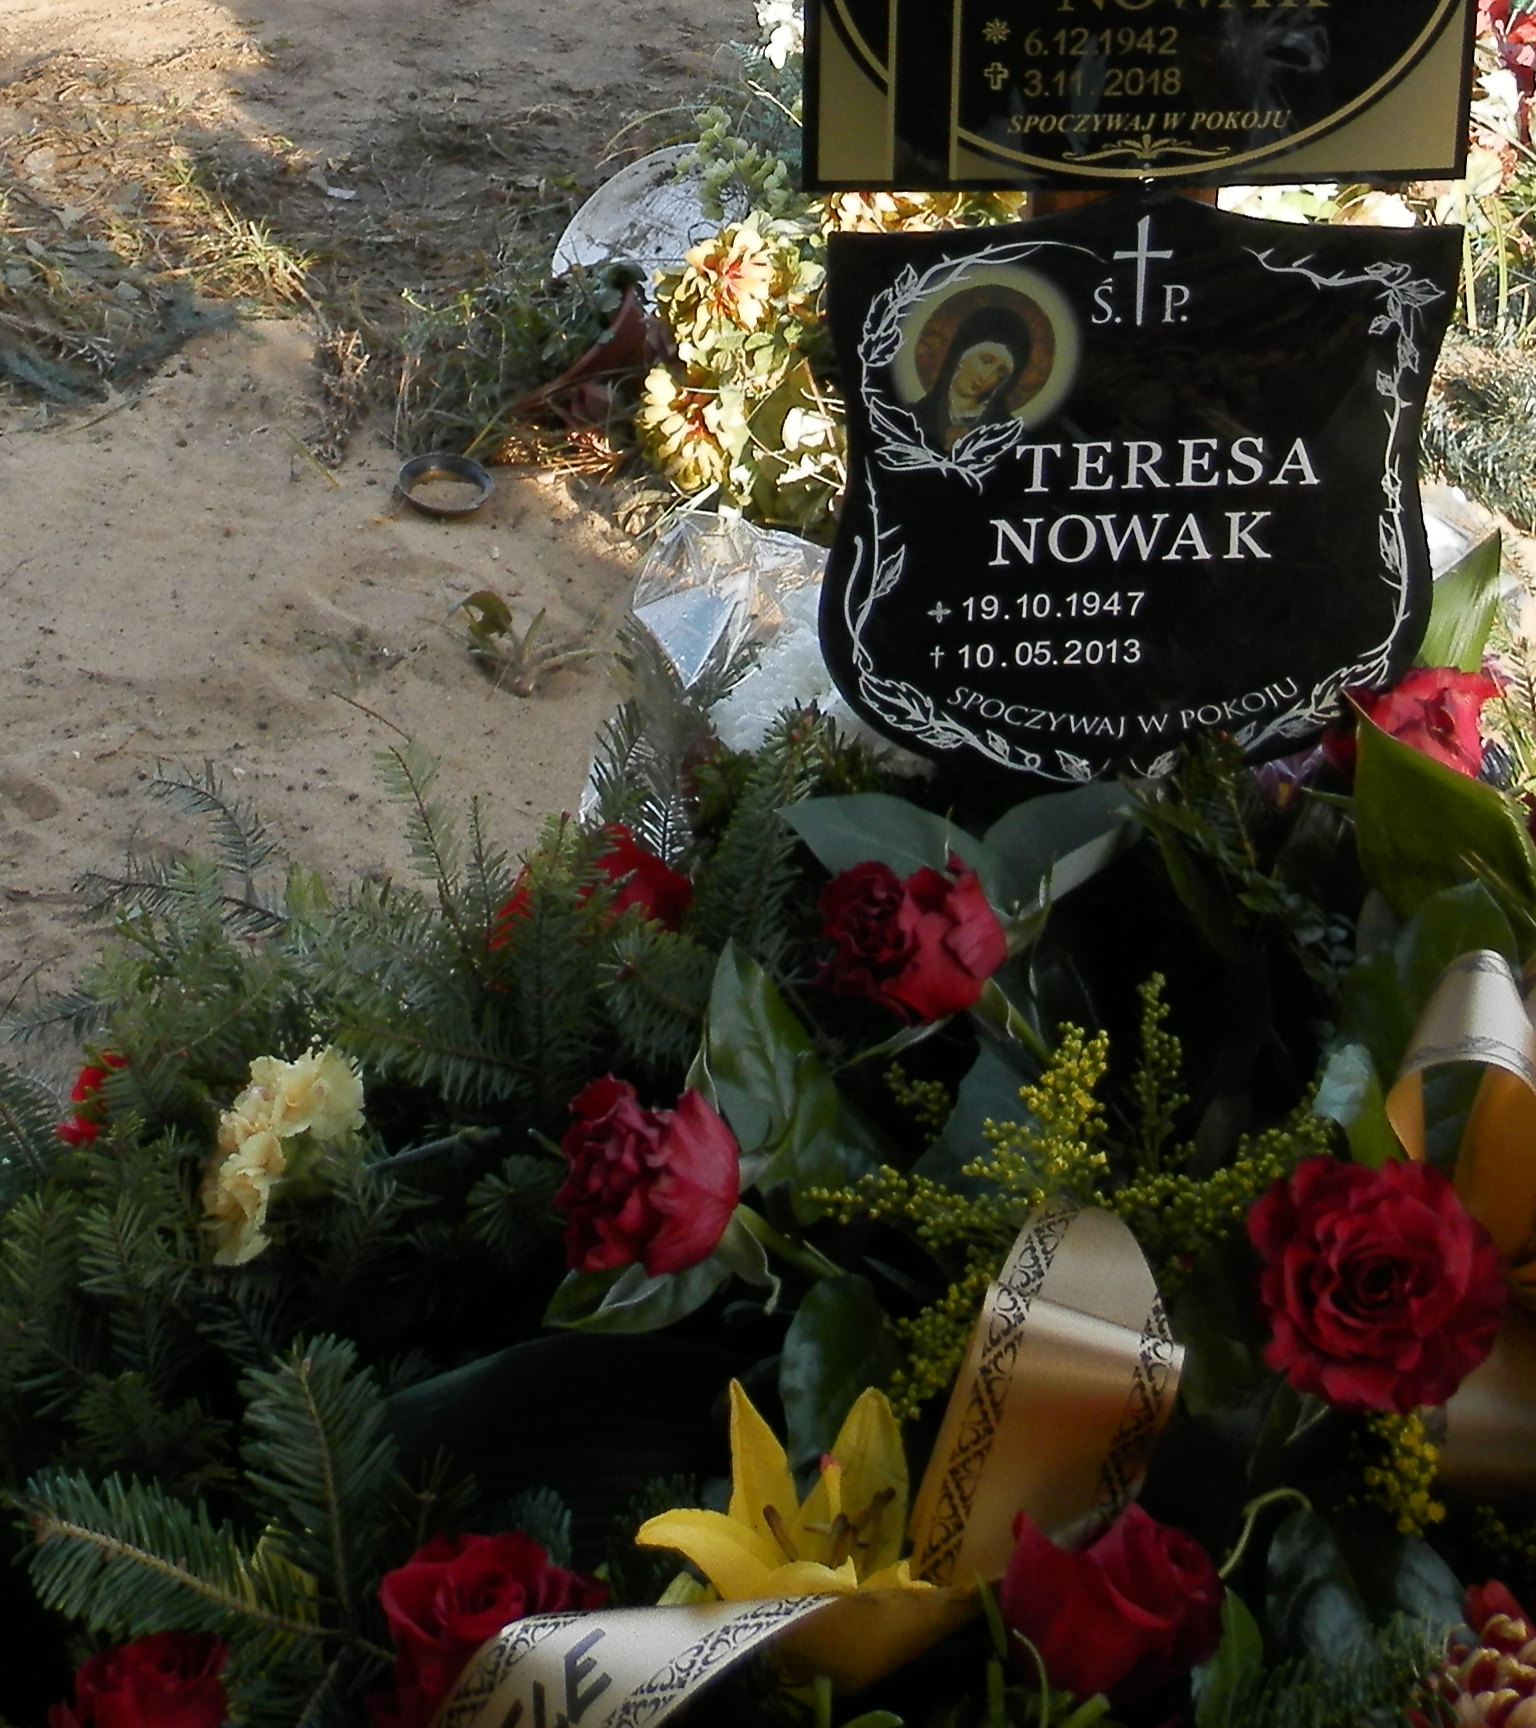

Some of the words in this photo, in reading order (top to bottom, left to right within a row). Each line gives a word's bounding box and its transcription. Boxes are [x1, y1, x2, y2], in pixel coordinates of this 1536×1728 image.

[1023, 26, 1179, 57] 6.12.1942
[1007, 112, 1157, 134] SPOCZYWAJ
[1161, 112, 1186, 130] W
[1190, 109, 1293, 131] POKOJU
[1015, 436, 1321, 493] TERESA
[988, 510, 1272, 567] NOWAK
[962, 591, 1146, 622] 19.10.1947
[957, 638, 1142, 670] 10.05.2013
[946, 685, 1125, 739] SPOCZYWAJ
[1137, 712, 1168, 734] W
[1181, 676, 1298, 729] POKOJU
